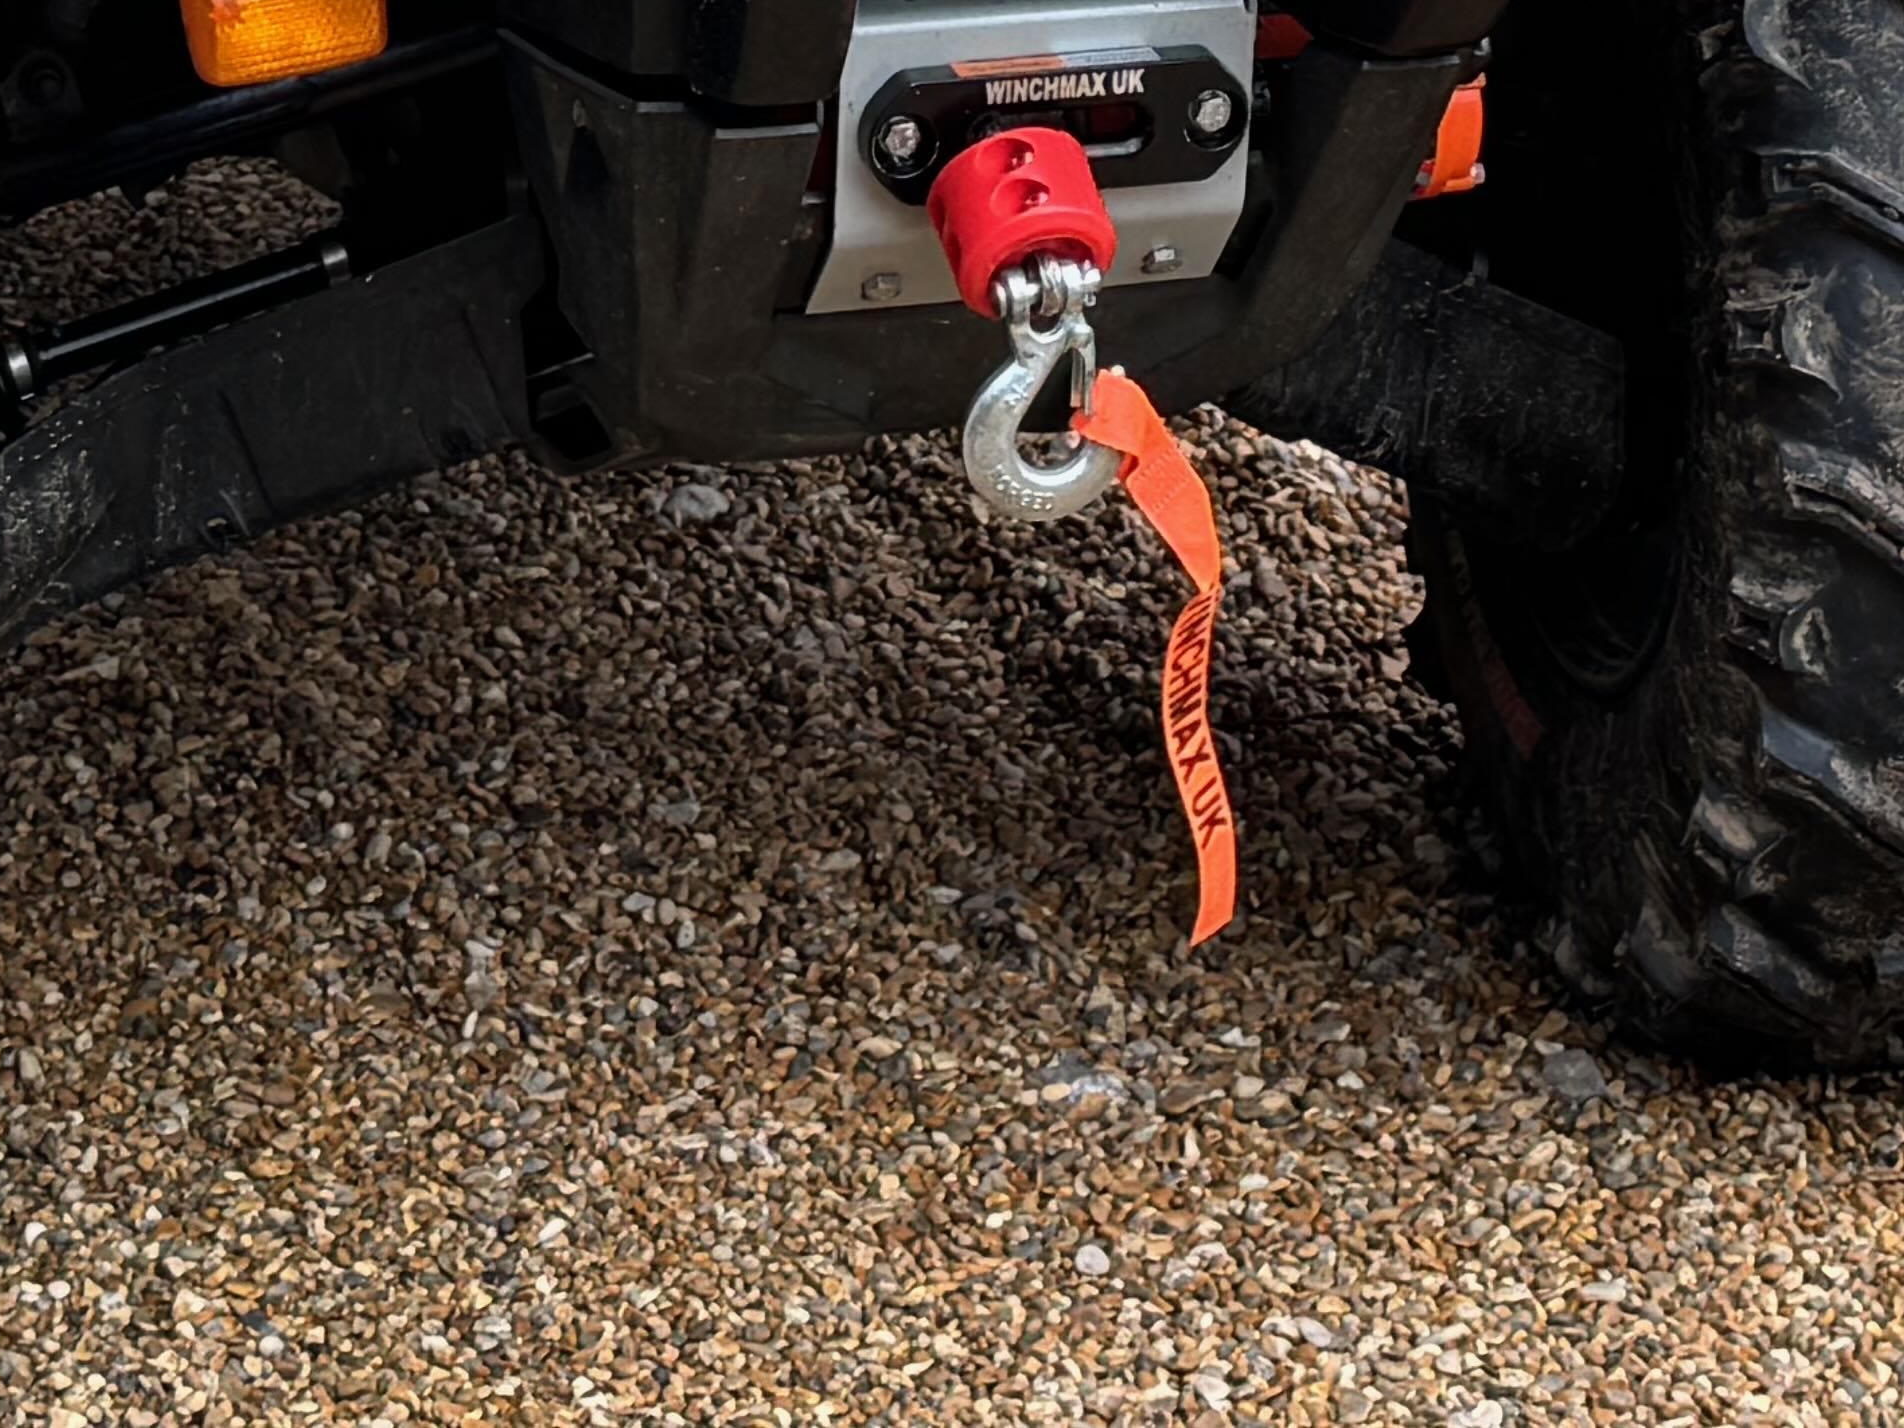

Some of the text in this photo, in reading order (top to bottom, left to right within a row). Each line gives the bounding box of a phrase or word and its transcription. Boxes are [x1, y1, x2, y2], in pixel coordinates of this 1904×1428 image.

[985, 68, 1145, 105] WINCHMAX UK
[1191, 776, 1228, 850] UK
